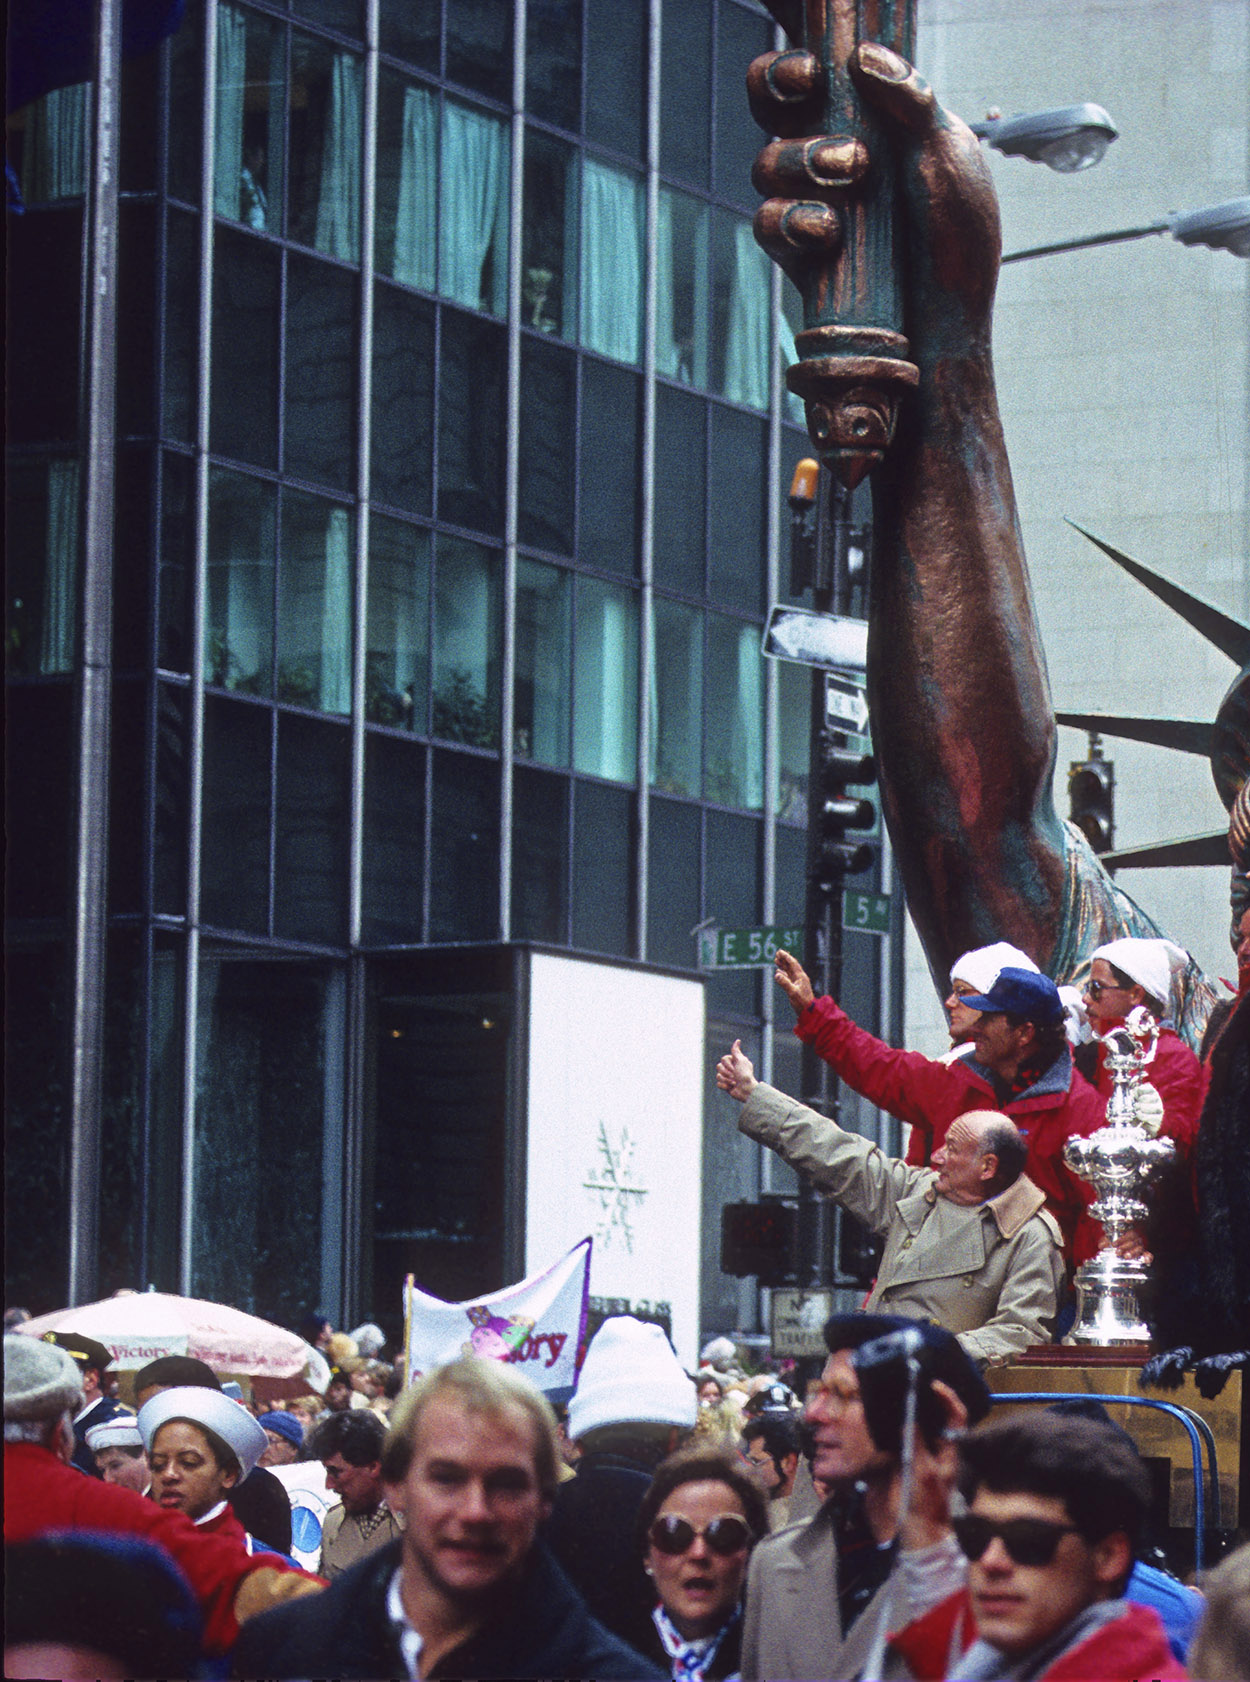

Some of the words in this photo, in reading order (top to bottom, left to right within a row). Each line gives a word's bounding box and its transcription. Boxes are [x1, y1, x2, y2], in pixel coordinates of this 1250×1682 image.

[857, 896, 870, 925] 5
[723, 933, 737, 962] E
[750, 931, 777, 961] 56
[784, 930, 799, 946] ST
